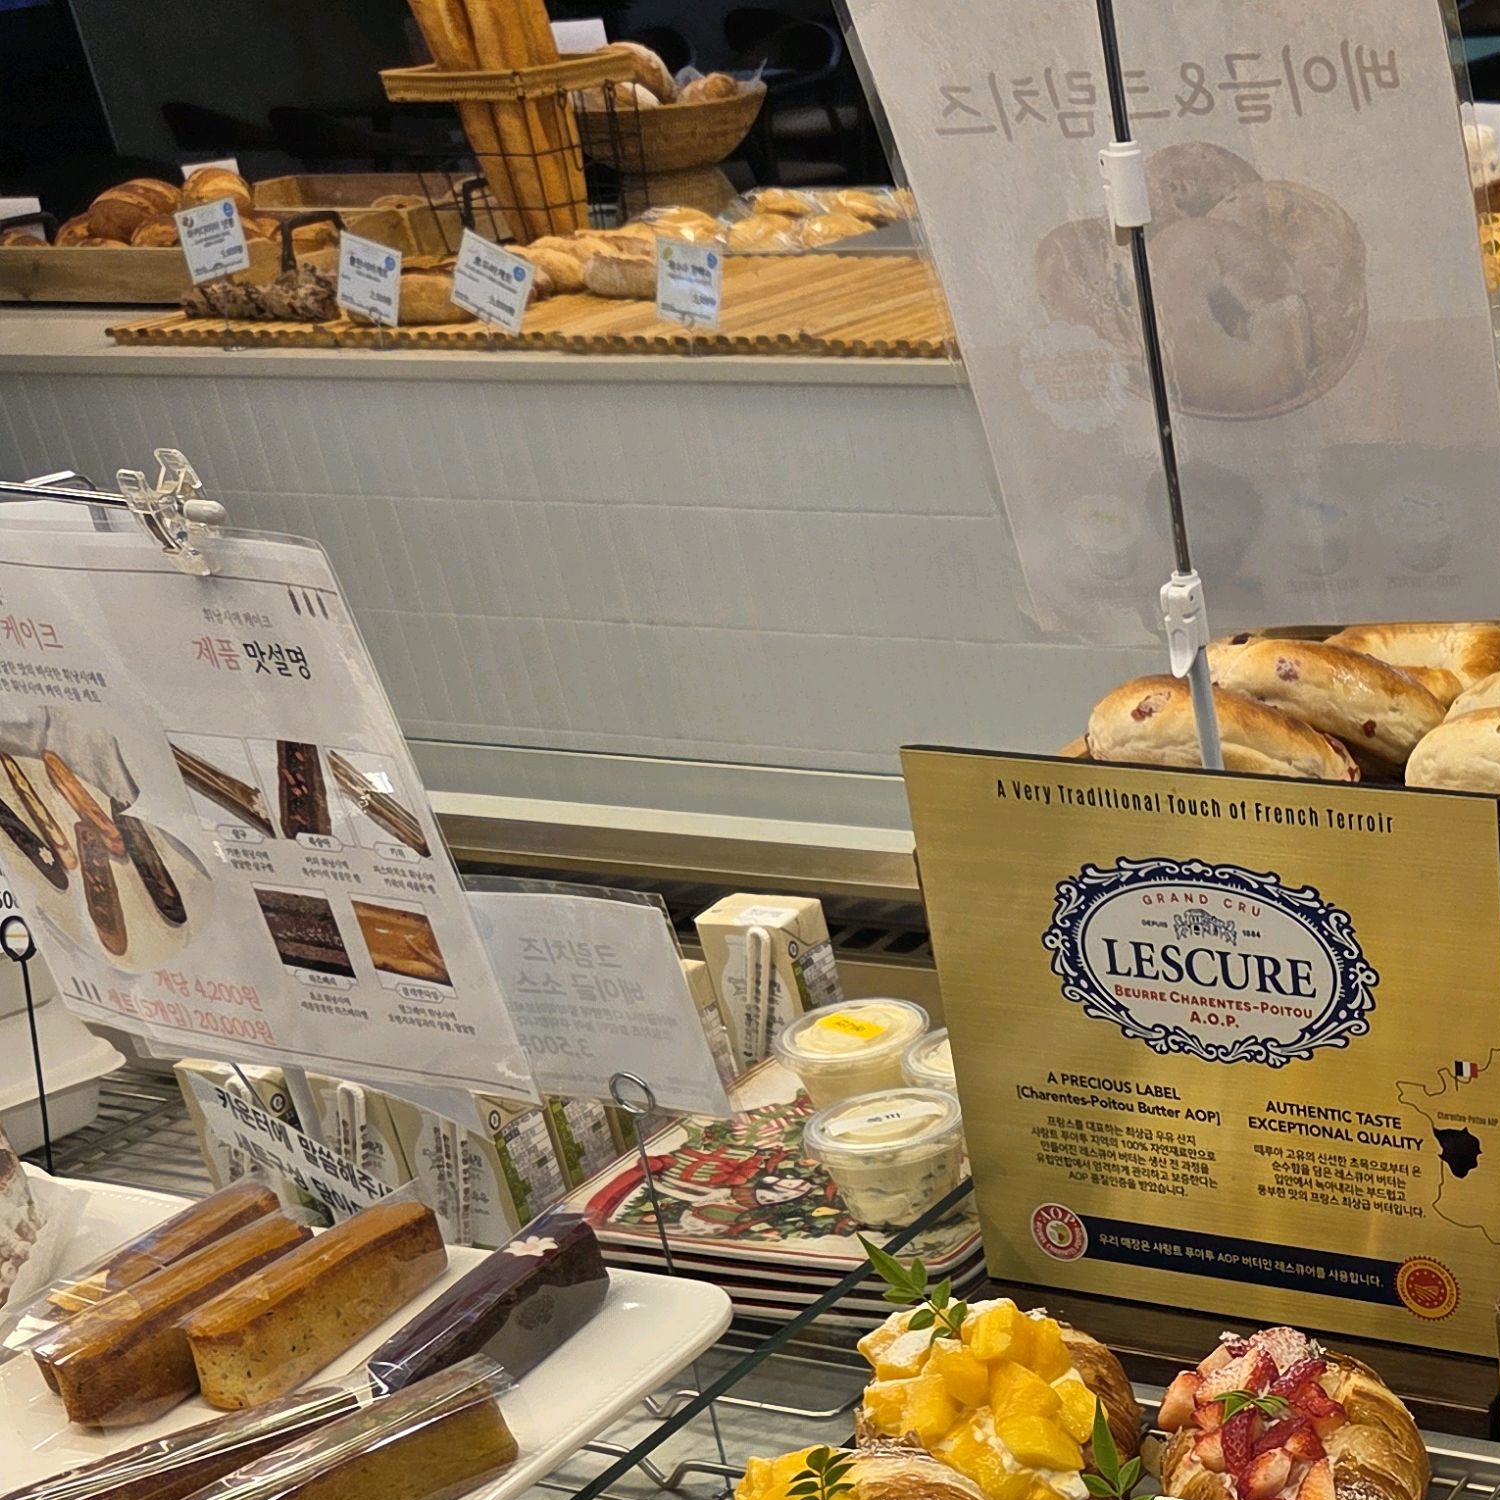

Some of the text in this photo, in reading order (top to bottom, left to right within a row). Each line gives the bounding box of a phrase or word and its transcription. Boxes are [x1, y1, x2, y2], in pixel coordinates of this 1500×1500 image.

[192, 637, 312, 680] 제품 맛설명
[997, 779, 1393, 834] A Very Traditional Touch of French Terroir
[1142, 892, 1262, 917] GRAND CRU
[1102, 938, 1317, 999] LESCURE
[194, 977, 263, 1012] 4,200원
[194, 1008, 277, 1047] 20,000원
[1190, 1011, 1239, 1028] A.O.P.
[1047, 1071, 1181, 1101] A PRECIOUS LABEL
[1016, 1085, 1221, 1126] [Charentes-Poitou Butter AOP]
[1266, 1100, 1402, 1130] AUTHENTIC TASTE
[1121, 1139, 1149, 1152] 100%
[1248, 1116, 1424, 1151] EXCEPTIONAL QUALITY
[1099, 1233, 1119, 1247] 우리
[1217, 1252, 1239, 1264] AOP
